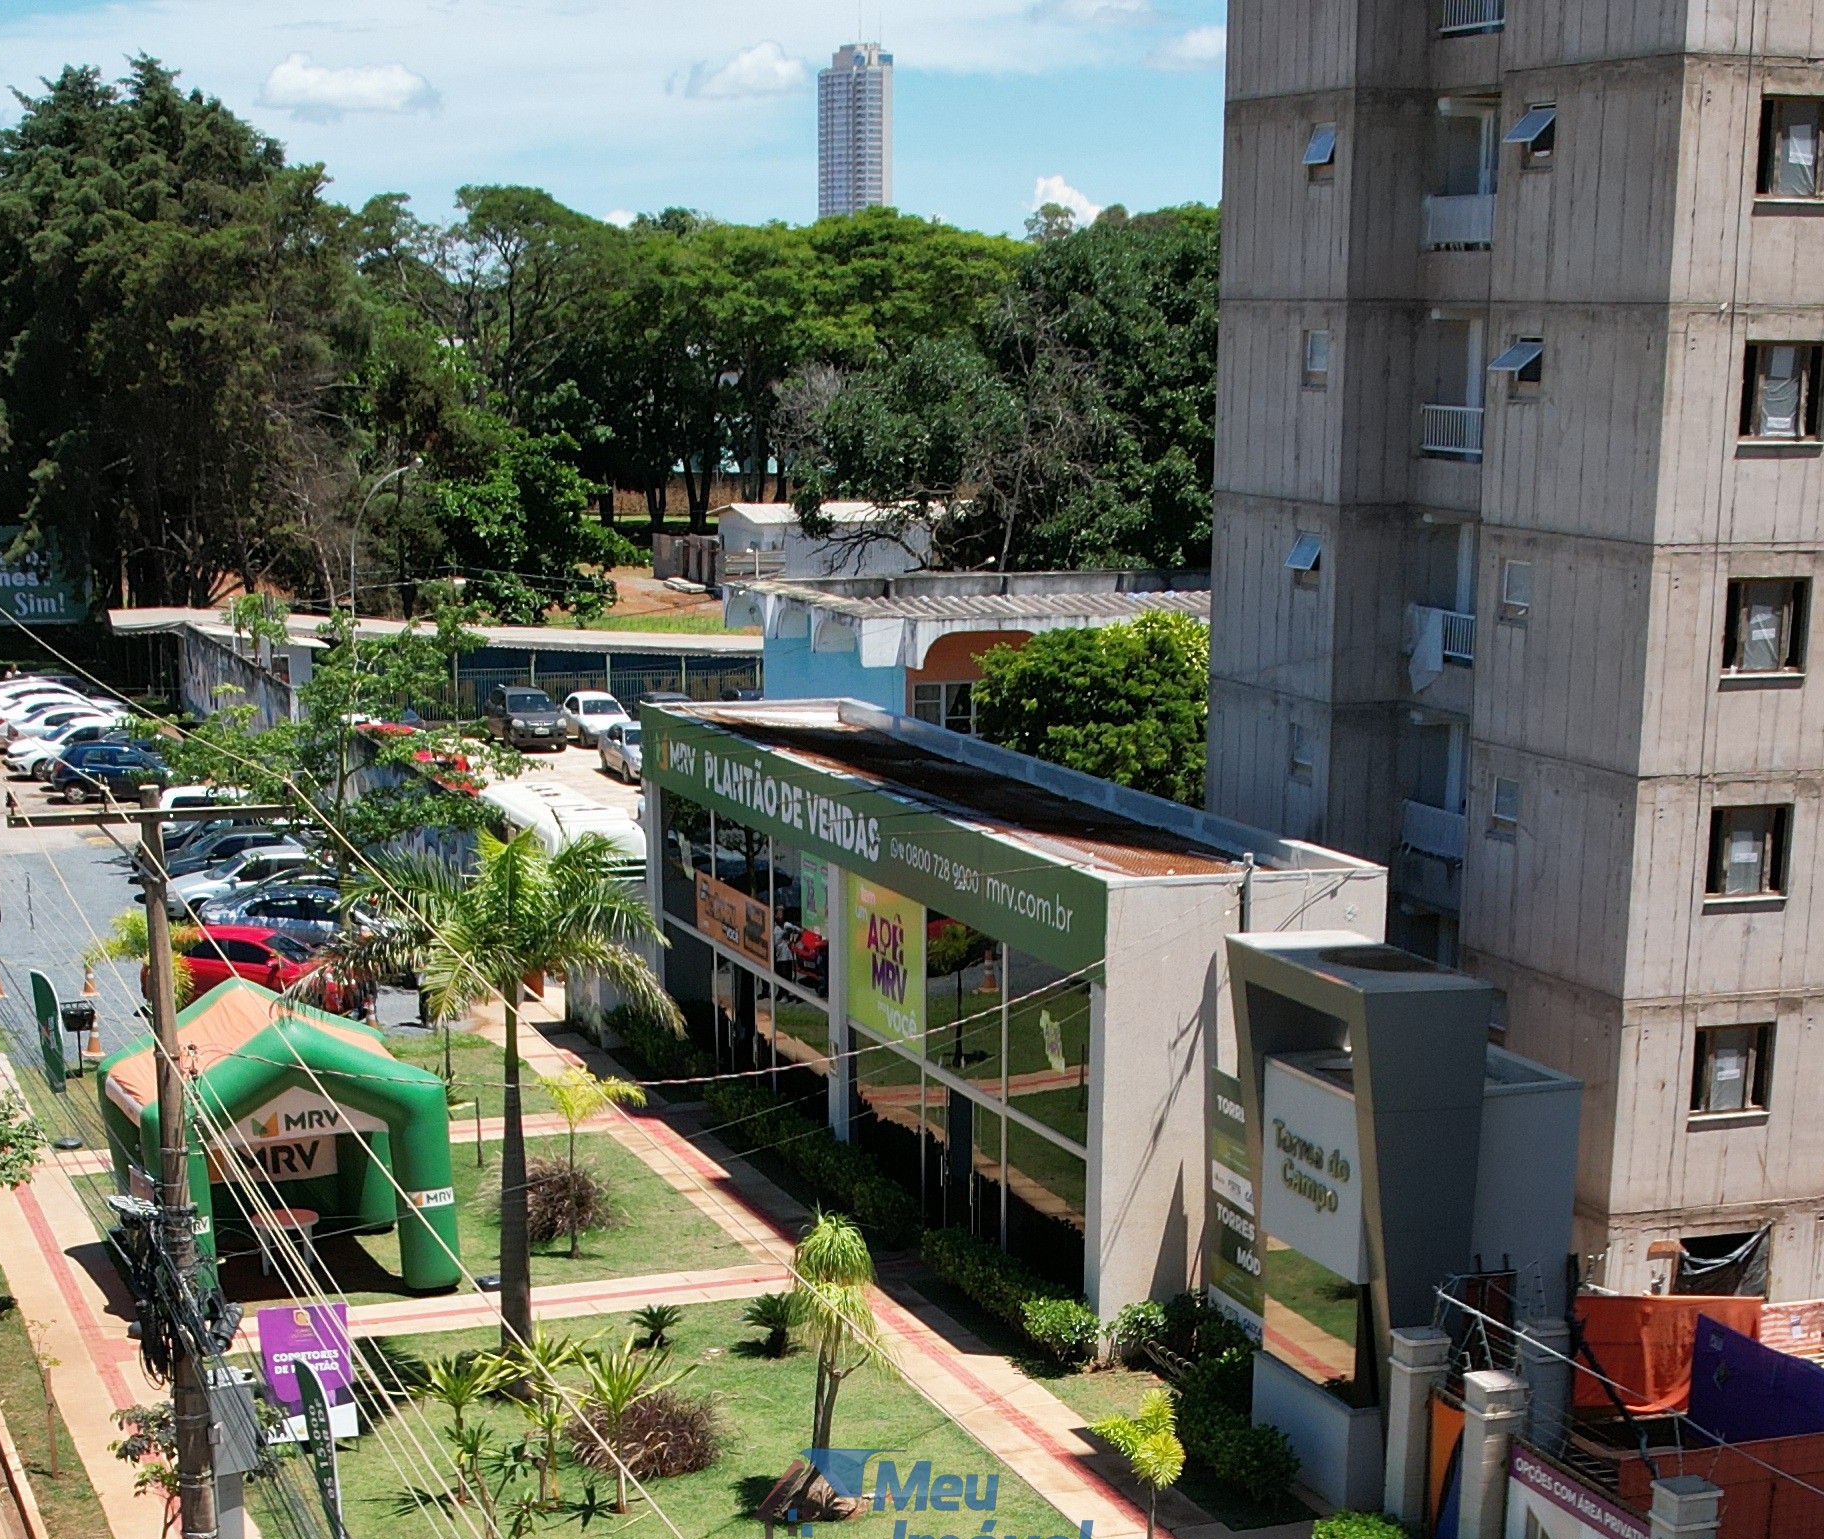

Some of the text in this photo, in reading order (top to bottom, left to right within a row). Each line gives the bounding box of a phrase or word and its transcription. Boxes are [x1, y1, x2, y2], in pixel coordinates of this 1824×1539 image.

[14, 591, 65, 616] Sim!
[669, 739, 1073, 934] MRV PLANTÃO DE VENDAS 0800 728 9000 mrv.com.br
[871, 951, 908, 1005] MRV
[284, 1109, 340, 1132] MRV
[238, 1140, 320, 1174] MRV
[1273, 1118, 1324, 1170] Torres
[1327, 1148, 1351, 1183] do
[426, 1189, 453, 1205] MRV
[1281, 1158, 1339, 1214] Campo
[192, 1218, 209, 1233] RV
[1216, 1202, 1255, 1242] TORRES
[274, 1365, 289, 1375] DE
[1515, 1457, 1554, 1491] OPÇÕES
[1554, 1481, 1577, 1507] COM
[1577, 1493, 1603, 1523] ÁREA
